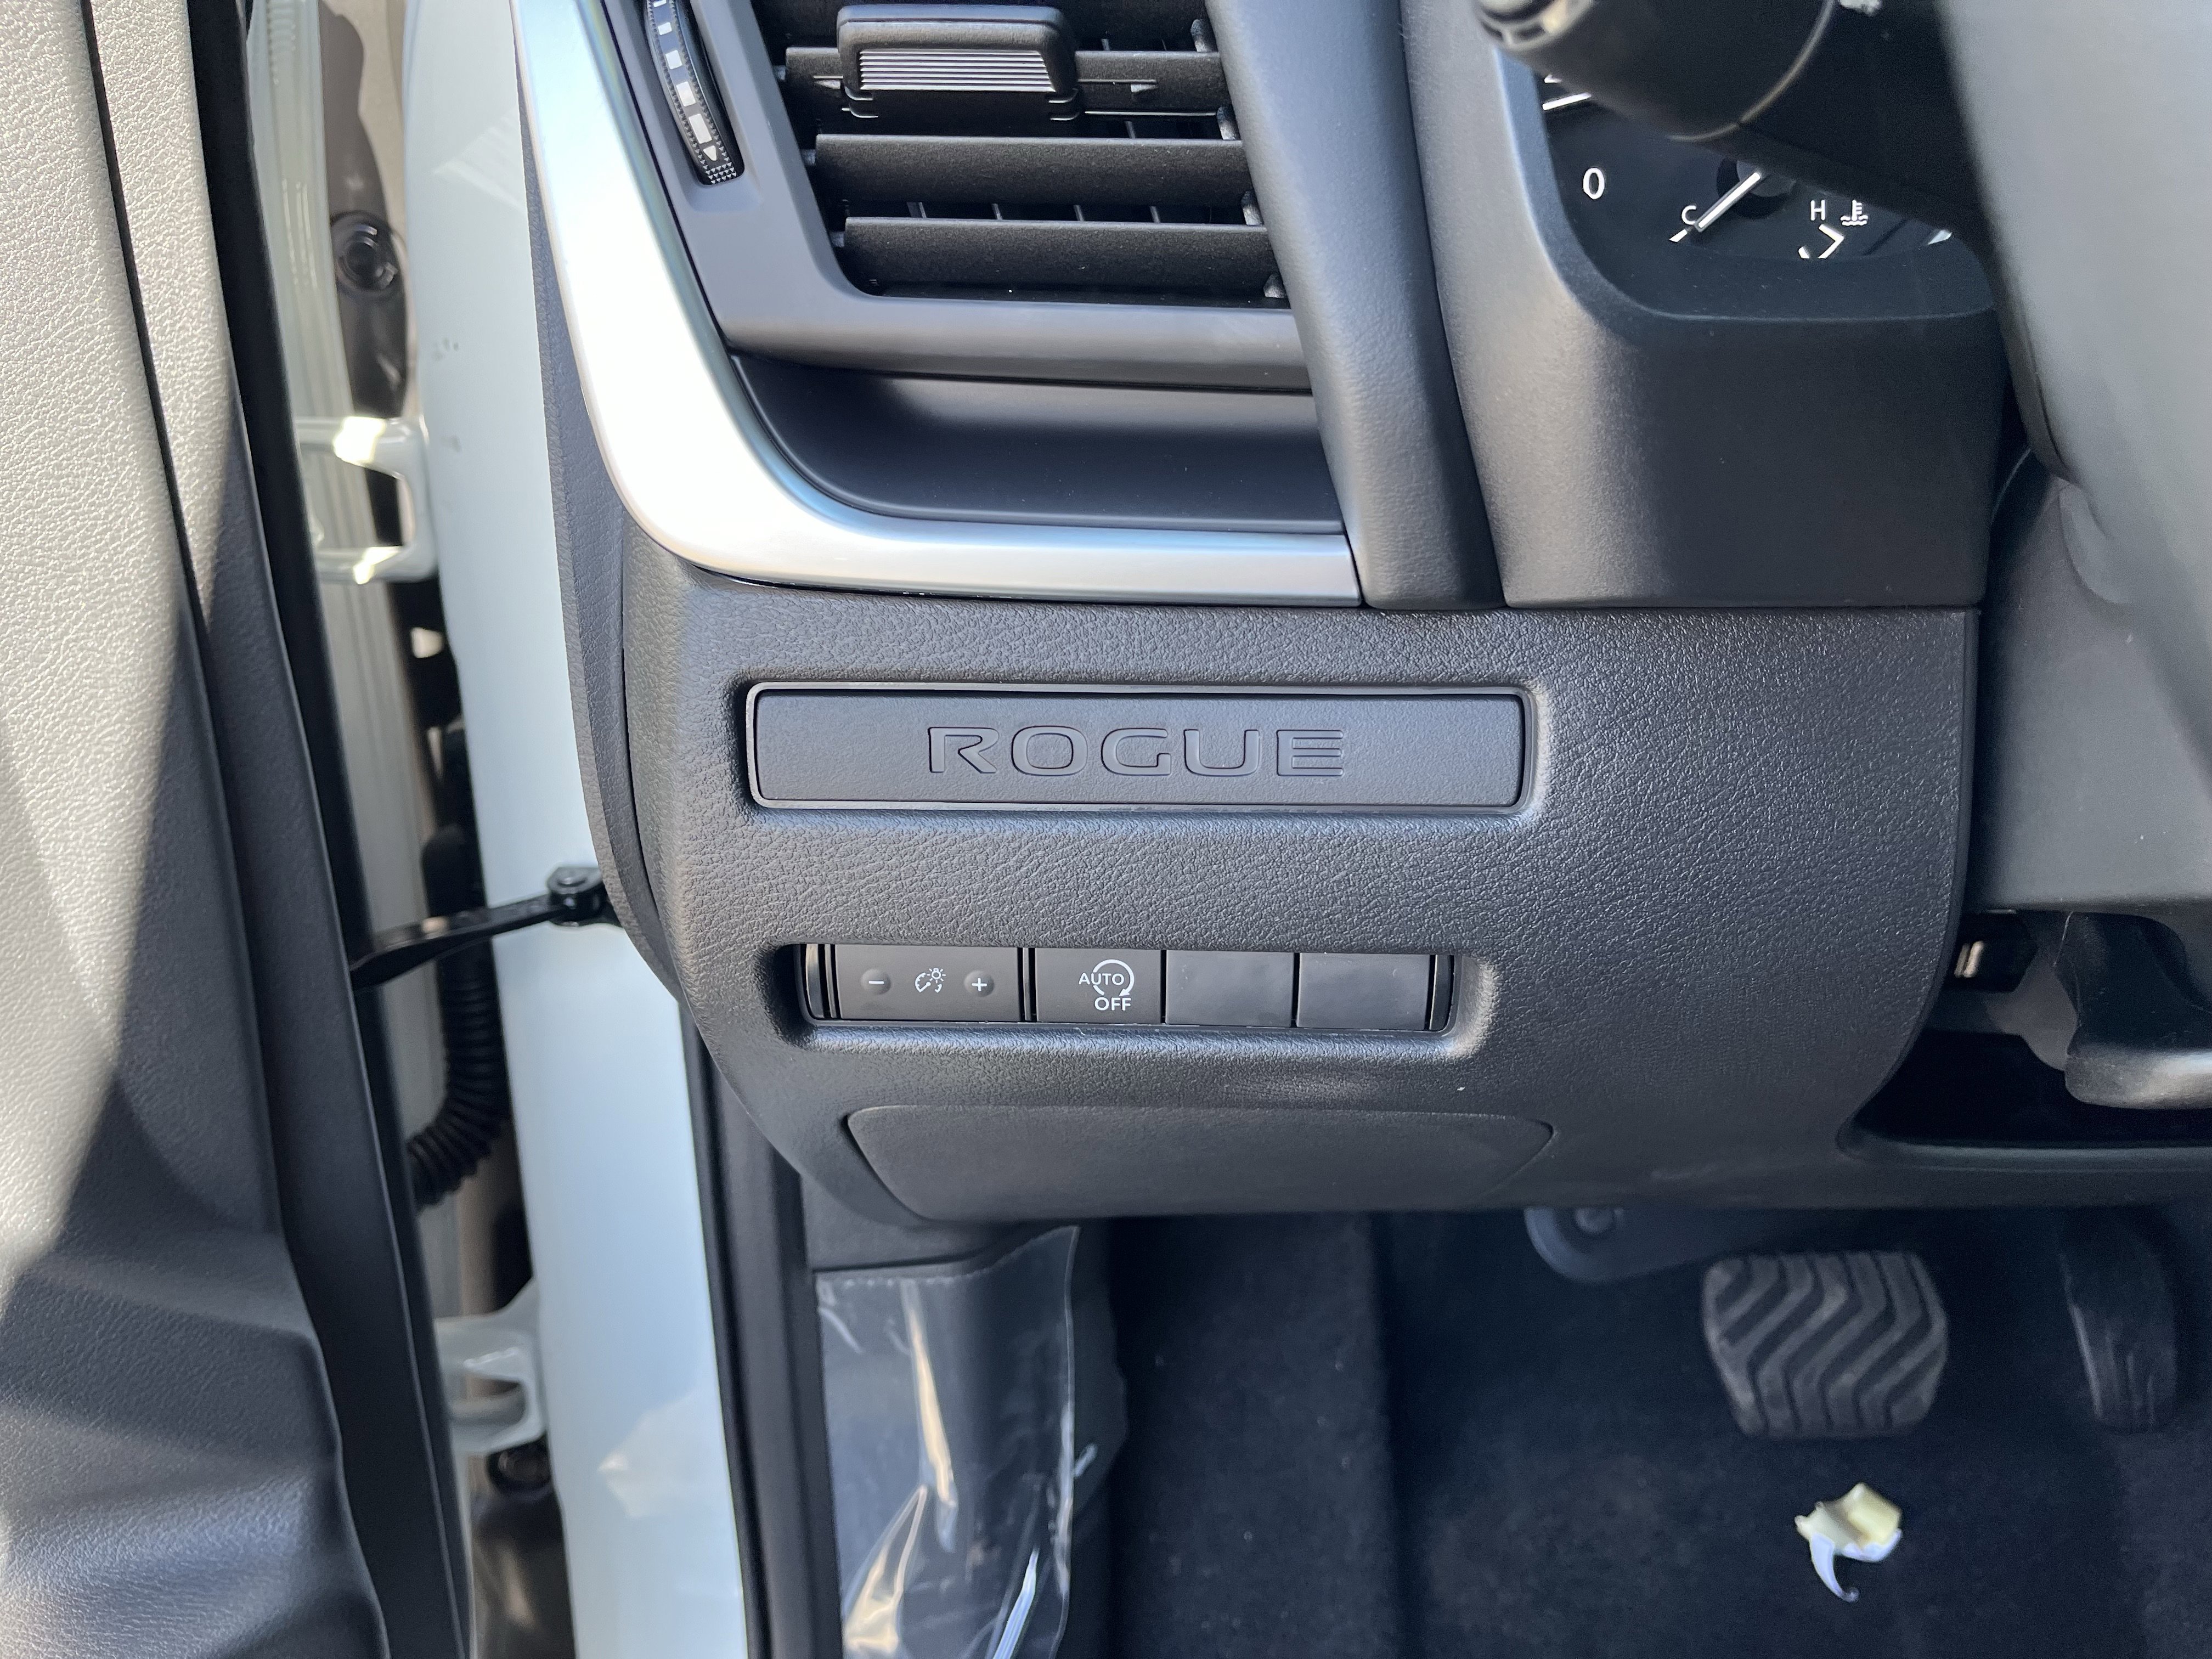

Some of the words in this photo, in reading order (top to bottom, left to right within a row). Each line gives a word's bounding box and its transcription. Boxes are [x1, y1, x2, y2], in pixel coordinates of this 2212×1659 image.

[1582, 167, 1605, 200] 0
[1681, 205, 1697, 225] C
[1810, 199, 1826, 221] H
[927, 725, 1345, 777] ROGUE
[1078, 972, 1125, 986] AUTO
[1094, 996, 1132, 1011] OFF
